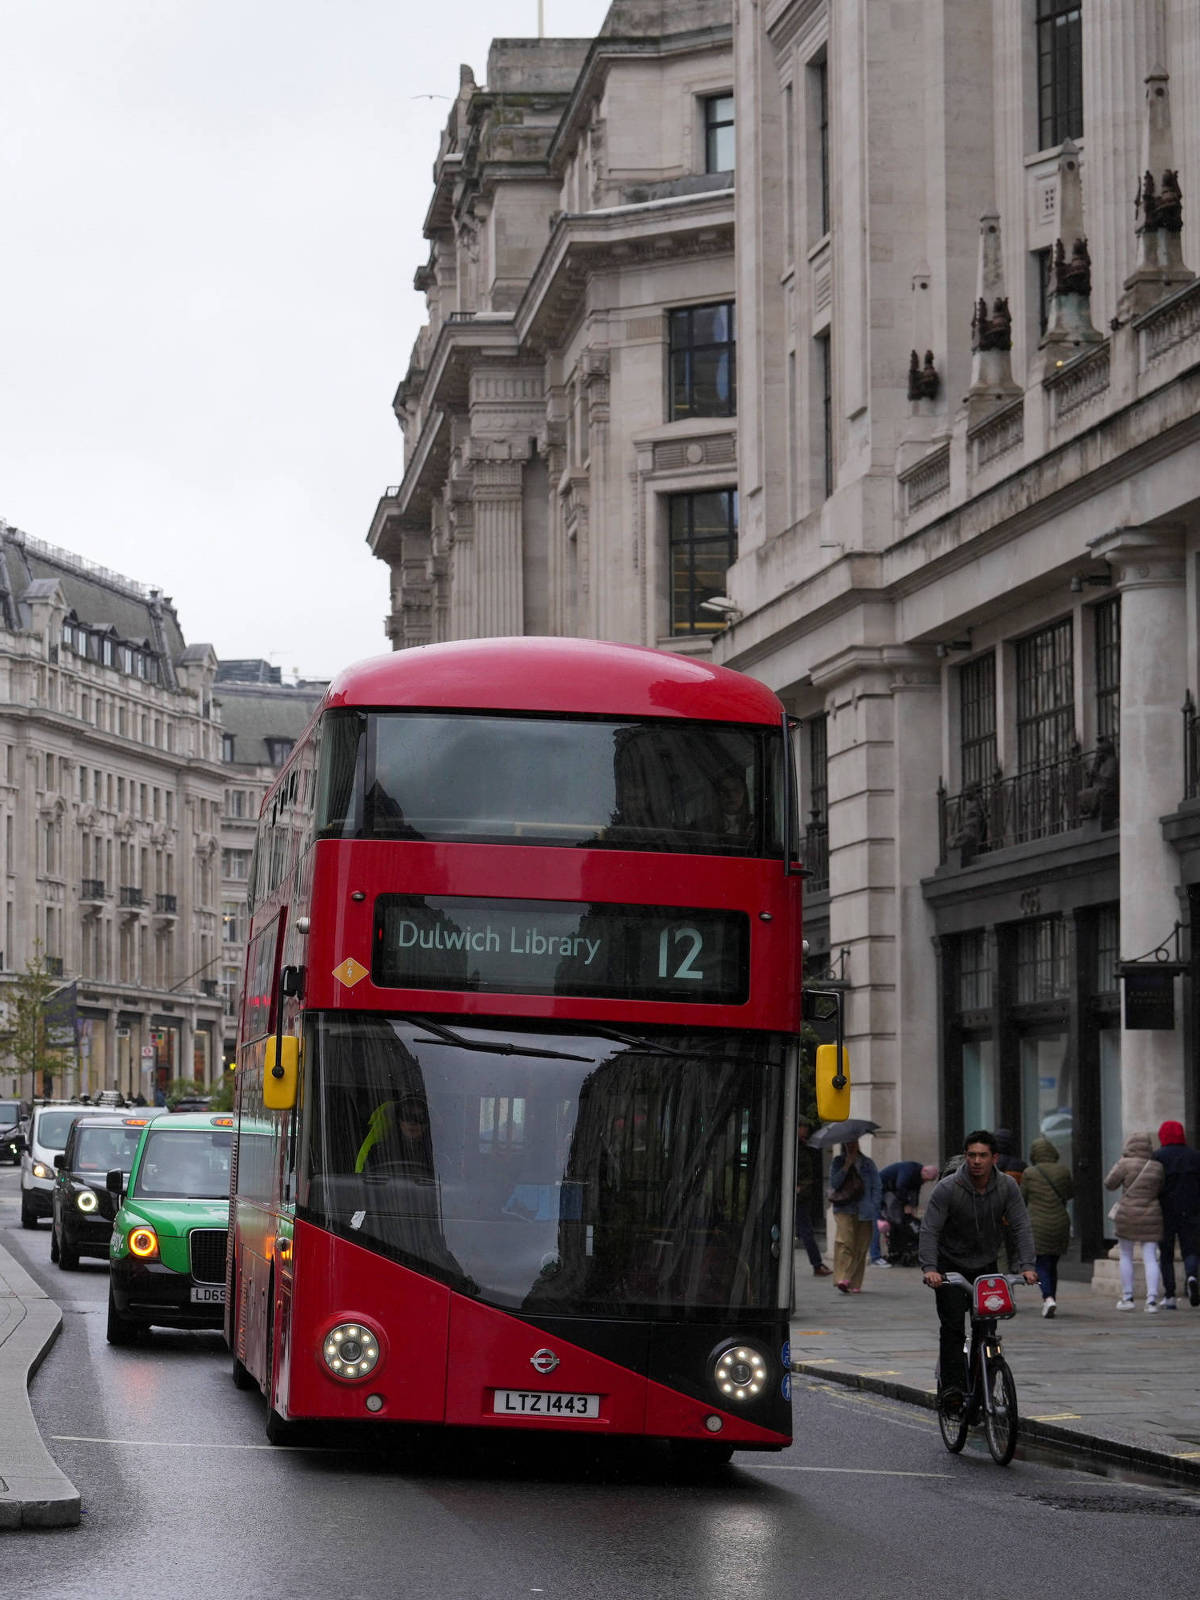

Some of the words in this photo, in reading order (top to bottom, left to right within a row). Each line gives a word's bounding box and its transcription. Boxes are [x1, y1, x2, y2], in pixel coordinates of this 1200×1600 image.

[399, 921, 500, 952] Dulwich
[510, 926, 601, 965] Library
[658, 927, 704, 979] 12
[505, 1393, 542, 1412] LTZ
[546, 1395, 588, 1414] 1443
